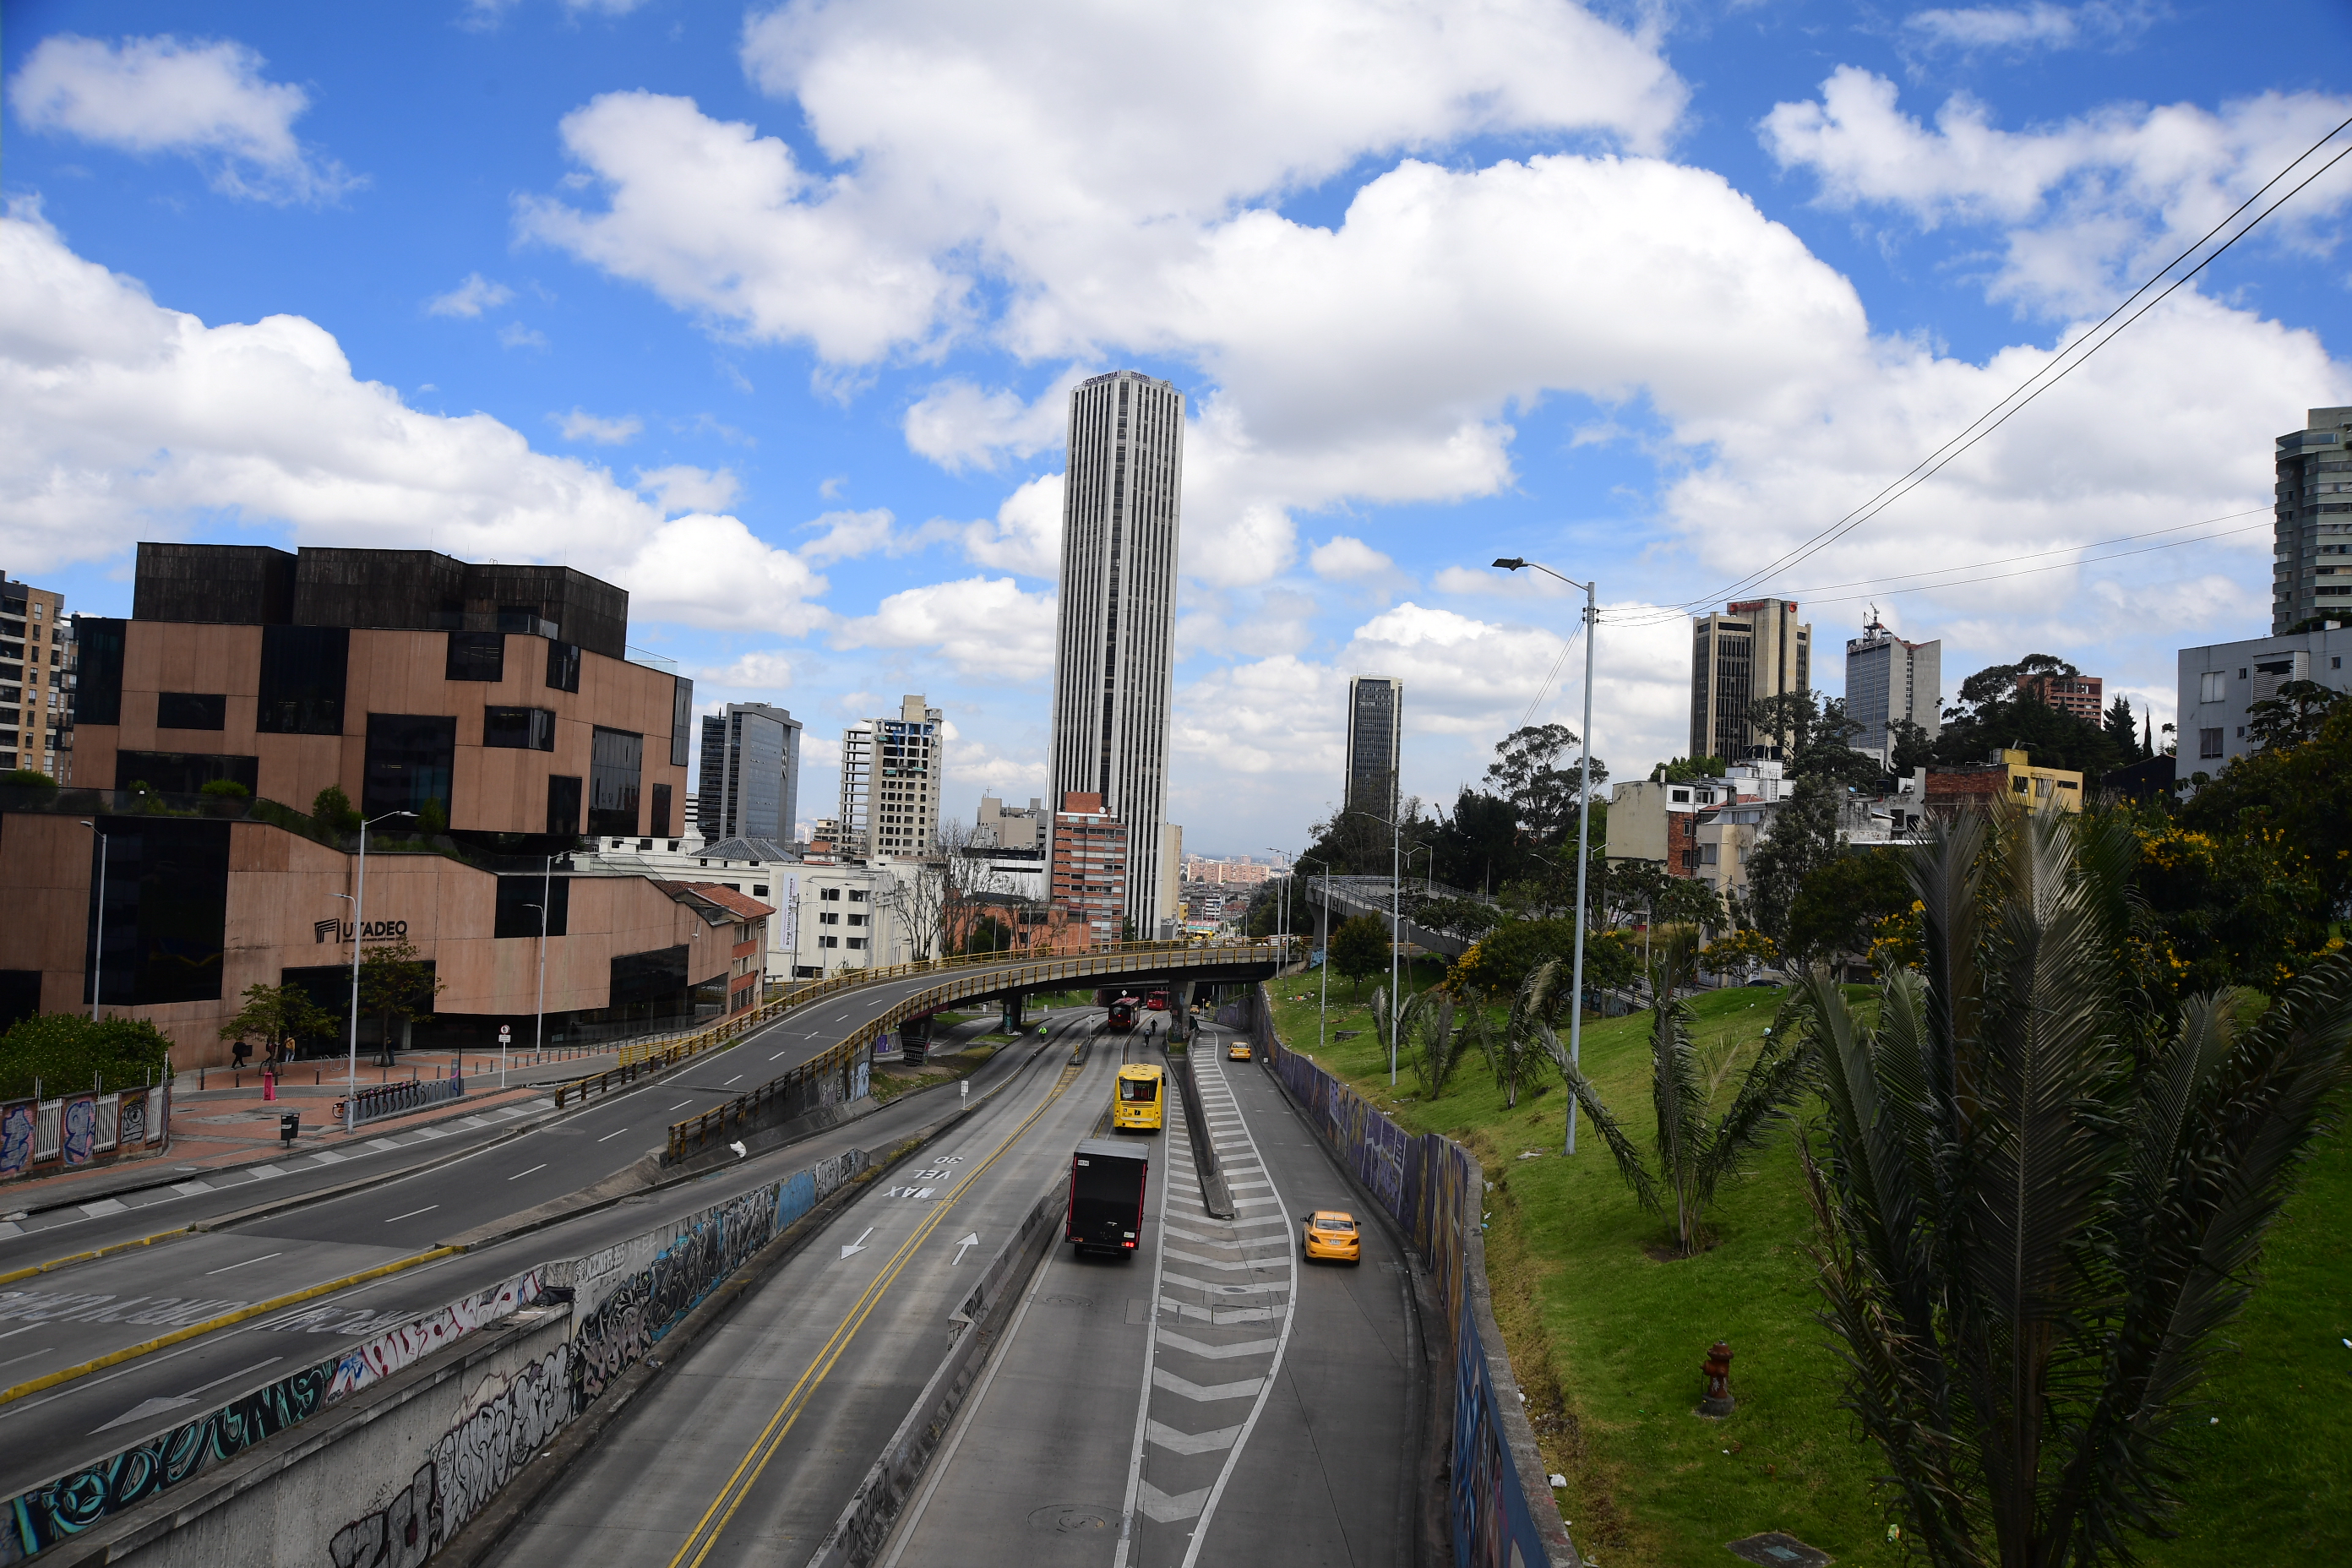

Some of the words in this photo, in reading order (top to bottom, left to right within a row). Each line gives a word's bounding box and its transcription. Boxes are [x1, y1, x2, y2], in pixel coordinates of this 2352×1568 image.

[933, 1156, 965, 1164] 30
[913, 1169, 951, 1179] VEL
[881, 1185, 937, 1198] MAX
